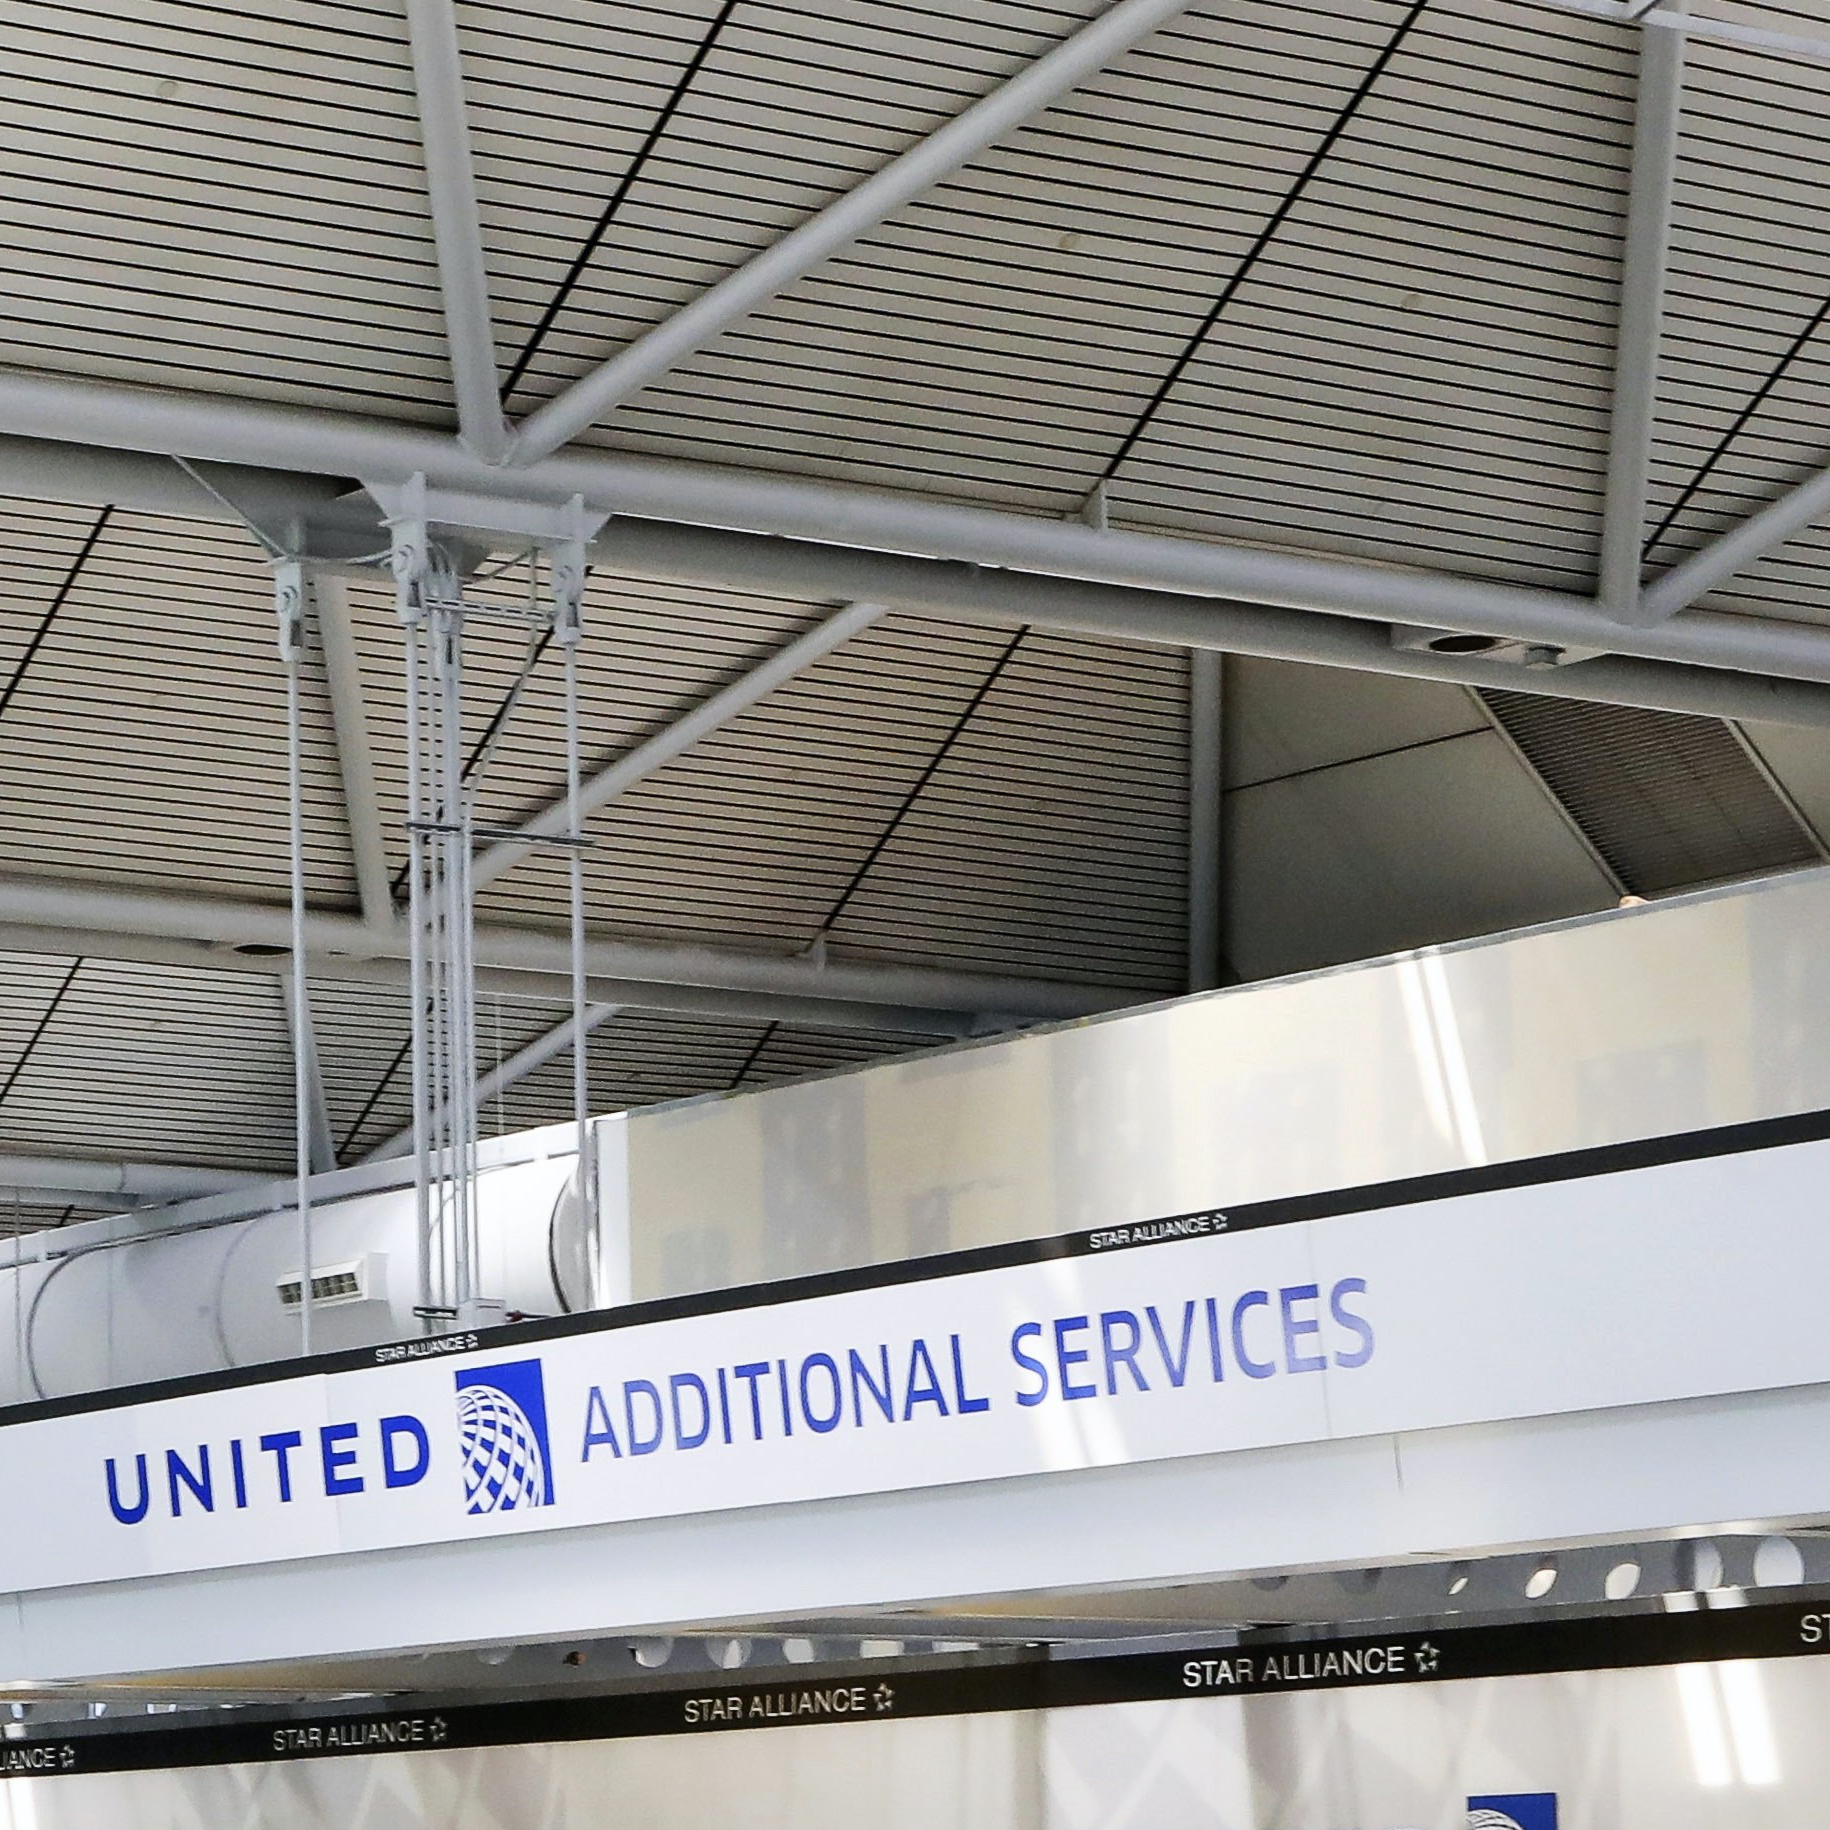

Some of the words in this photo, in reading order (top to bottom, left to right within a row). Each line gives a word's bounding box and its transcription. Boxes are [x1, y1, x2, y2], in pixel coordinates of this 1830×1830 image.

[1090, 1228, 1130, 1249] STAR
[1132, 1216, 1211, 1242] ALLIANCE
[375, 1346, 406, 1362] STAR
[407, 1335, 465, 1357] ALLIANCE
[105, 1415, 430, 1525] UNITED
[582, 1333, 991, 1462] ADDITIONAL
[1010, 1277, 1376, 1408] SERVICES
[1182, 1657, 1255, 1688] STAR
[1261, 1647, 1406, 1682] ALLIANCE
[684, 1696, 743, 1724] STAR
[748, 1687, 866, 1719] ALLIANCE
[273, 1728, 322, 1752] STAR
[325, 1720, 425, 1748] ALLIANCE
